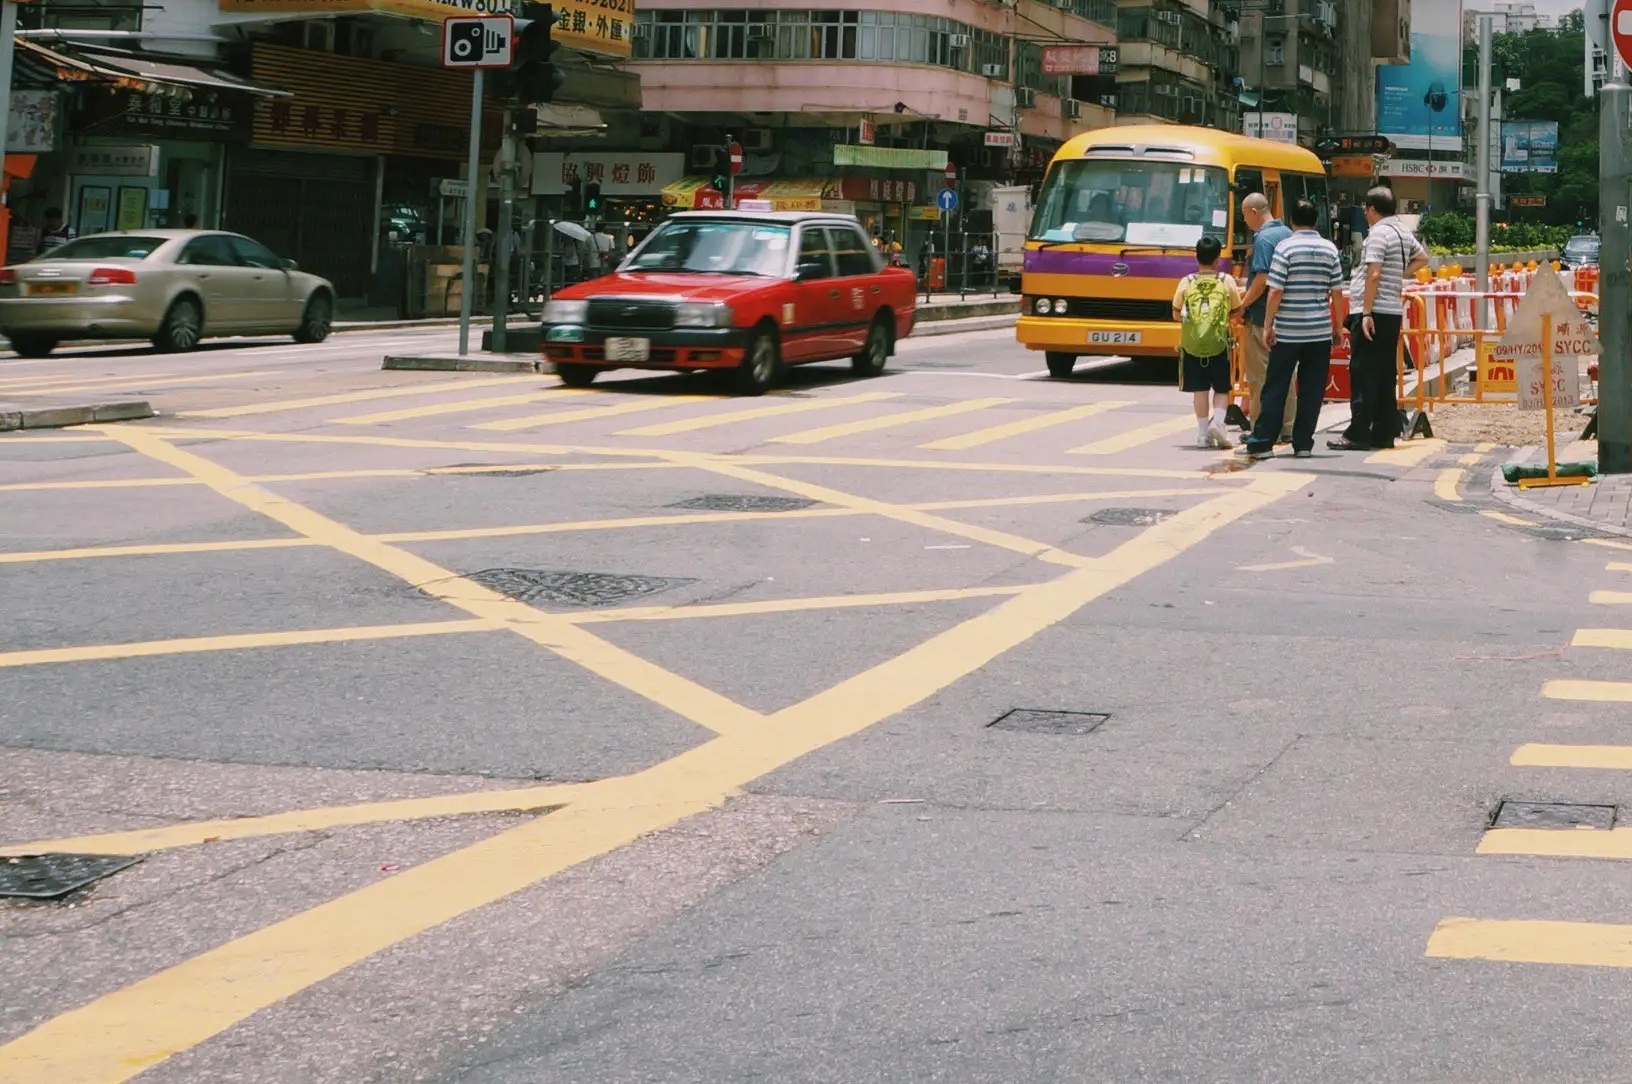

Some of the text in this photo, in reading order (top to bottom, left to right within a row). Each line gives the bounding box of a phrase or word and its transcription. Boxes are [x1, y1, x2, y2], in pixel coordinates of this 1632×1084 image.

[1401, 163, 1425, 173] HSBC
[1113, 331, 1136, 343] 214
[1555, 339, 1592, 354] SYCC
